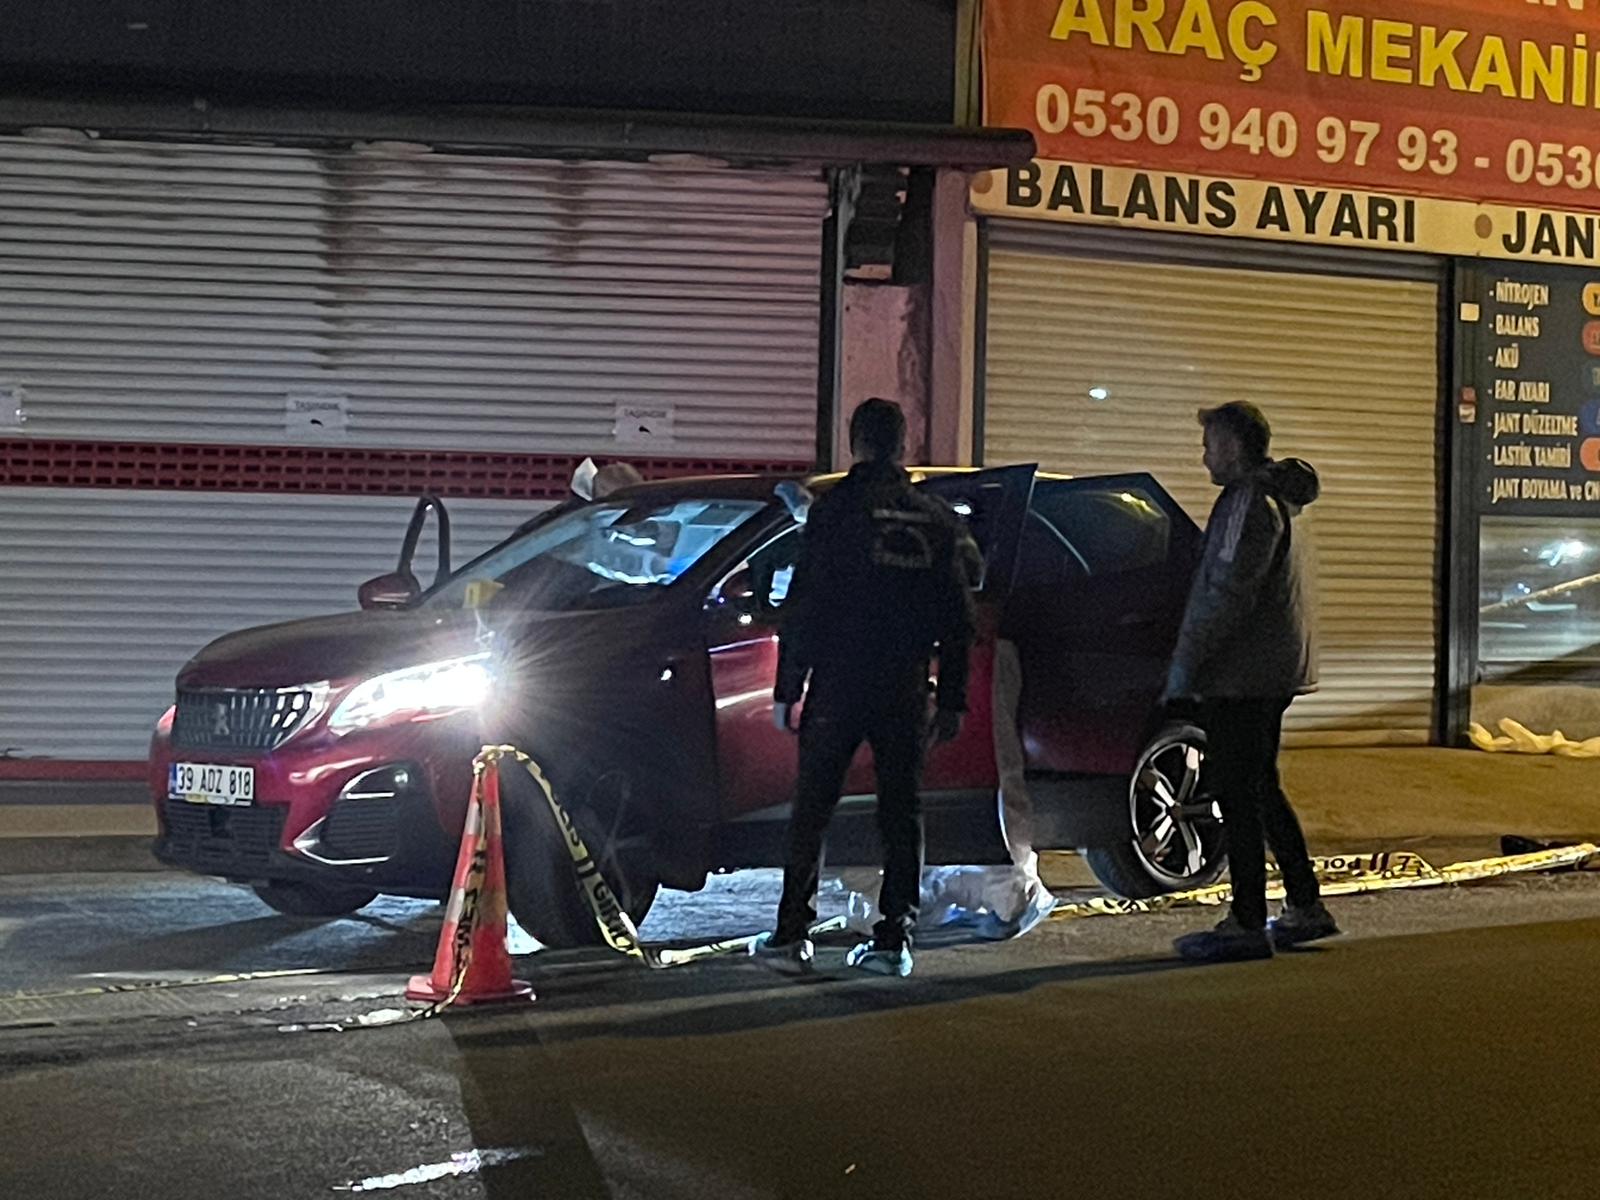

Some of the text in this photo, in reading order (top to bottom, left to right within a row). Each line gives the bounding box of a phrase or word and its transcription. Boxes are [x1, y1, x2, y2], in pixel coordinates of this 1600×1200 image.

[1050, 0, 1600, 109] ARAÇ MEKANİ
[1035, 84, 1179, 145] 0530
[1199, 102, 1298, 158] 940
[1316, 116, 1381, 166] 97
[1397, 126, 1458, 175] 93
[1506, 138, 1600, 189] 053
[1006, 163, 1416, 243] BALANS AYARI
[1502, 210, 1600, 259] JAN
[1496, 313, 1540, 337] BALANS
[1517, 381, 1550, 403] AYARI
[1493, 412, 1521, 439] JANT
[1522, 409, 1578, 437] DÜZELTME
[1492, 478, 1520, 504] JANT
[1521, 479, 1568, 500] BOYAMA
[1569, 484, 1583, 501] ve
[178, 766, 251, 796] 39 ADZ 818
